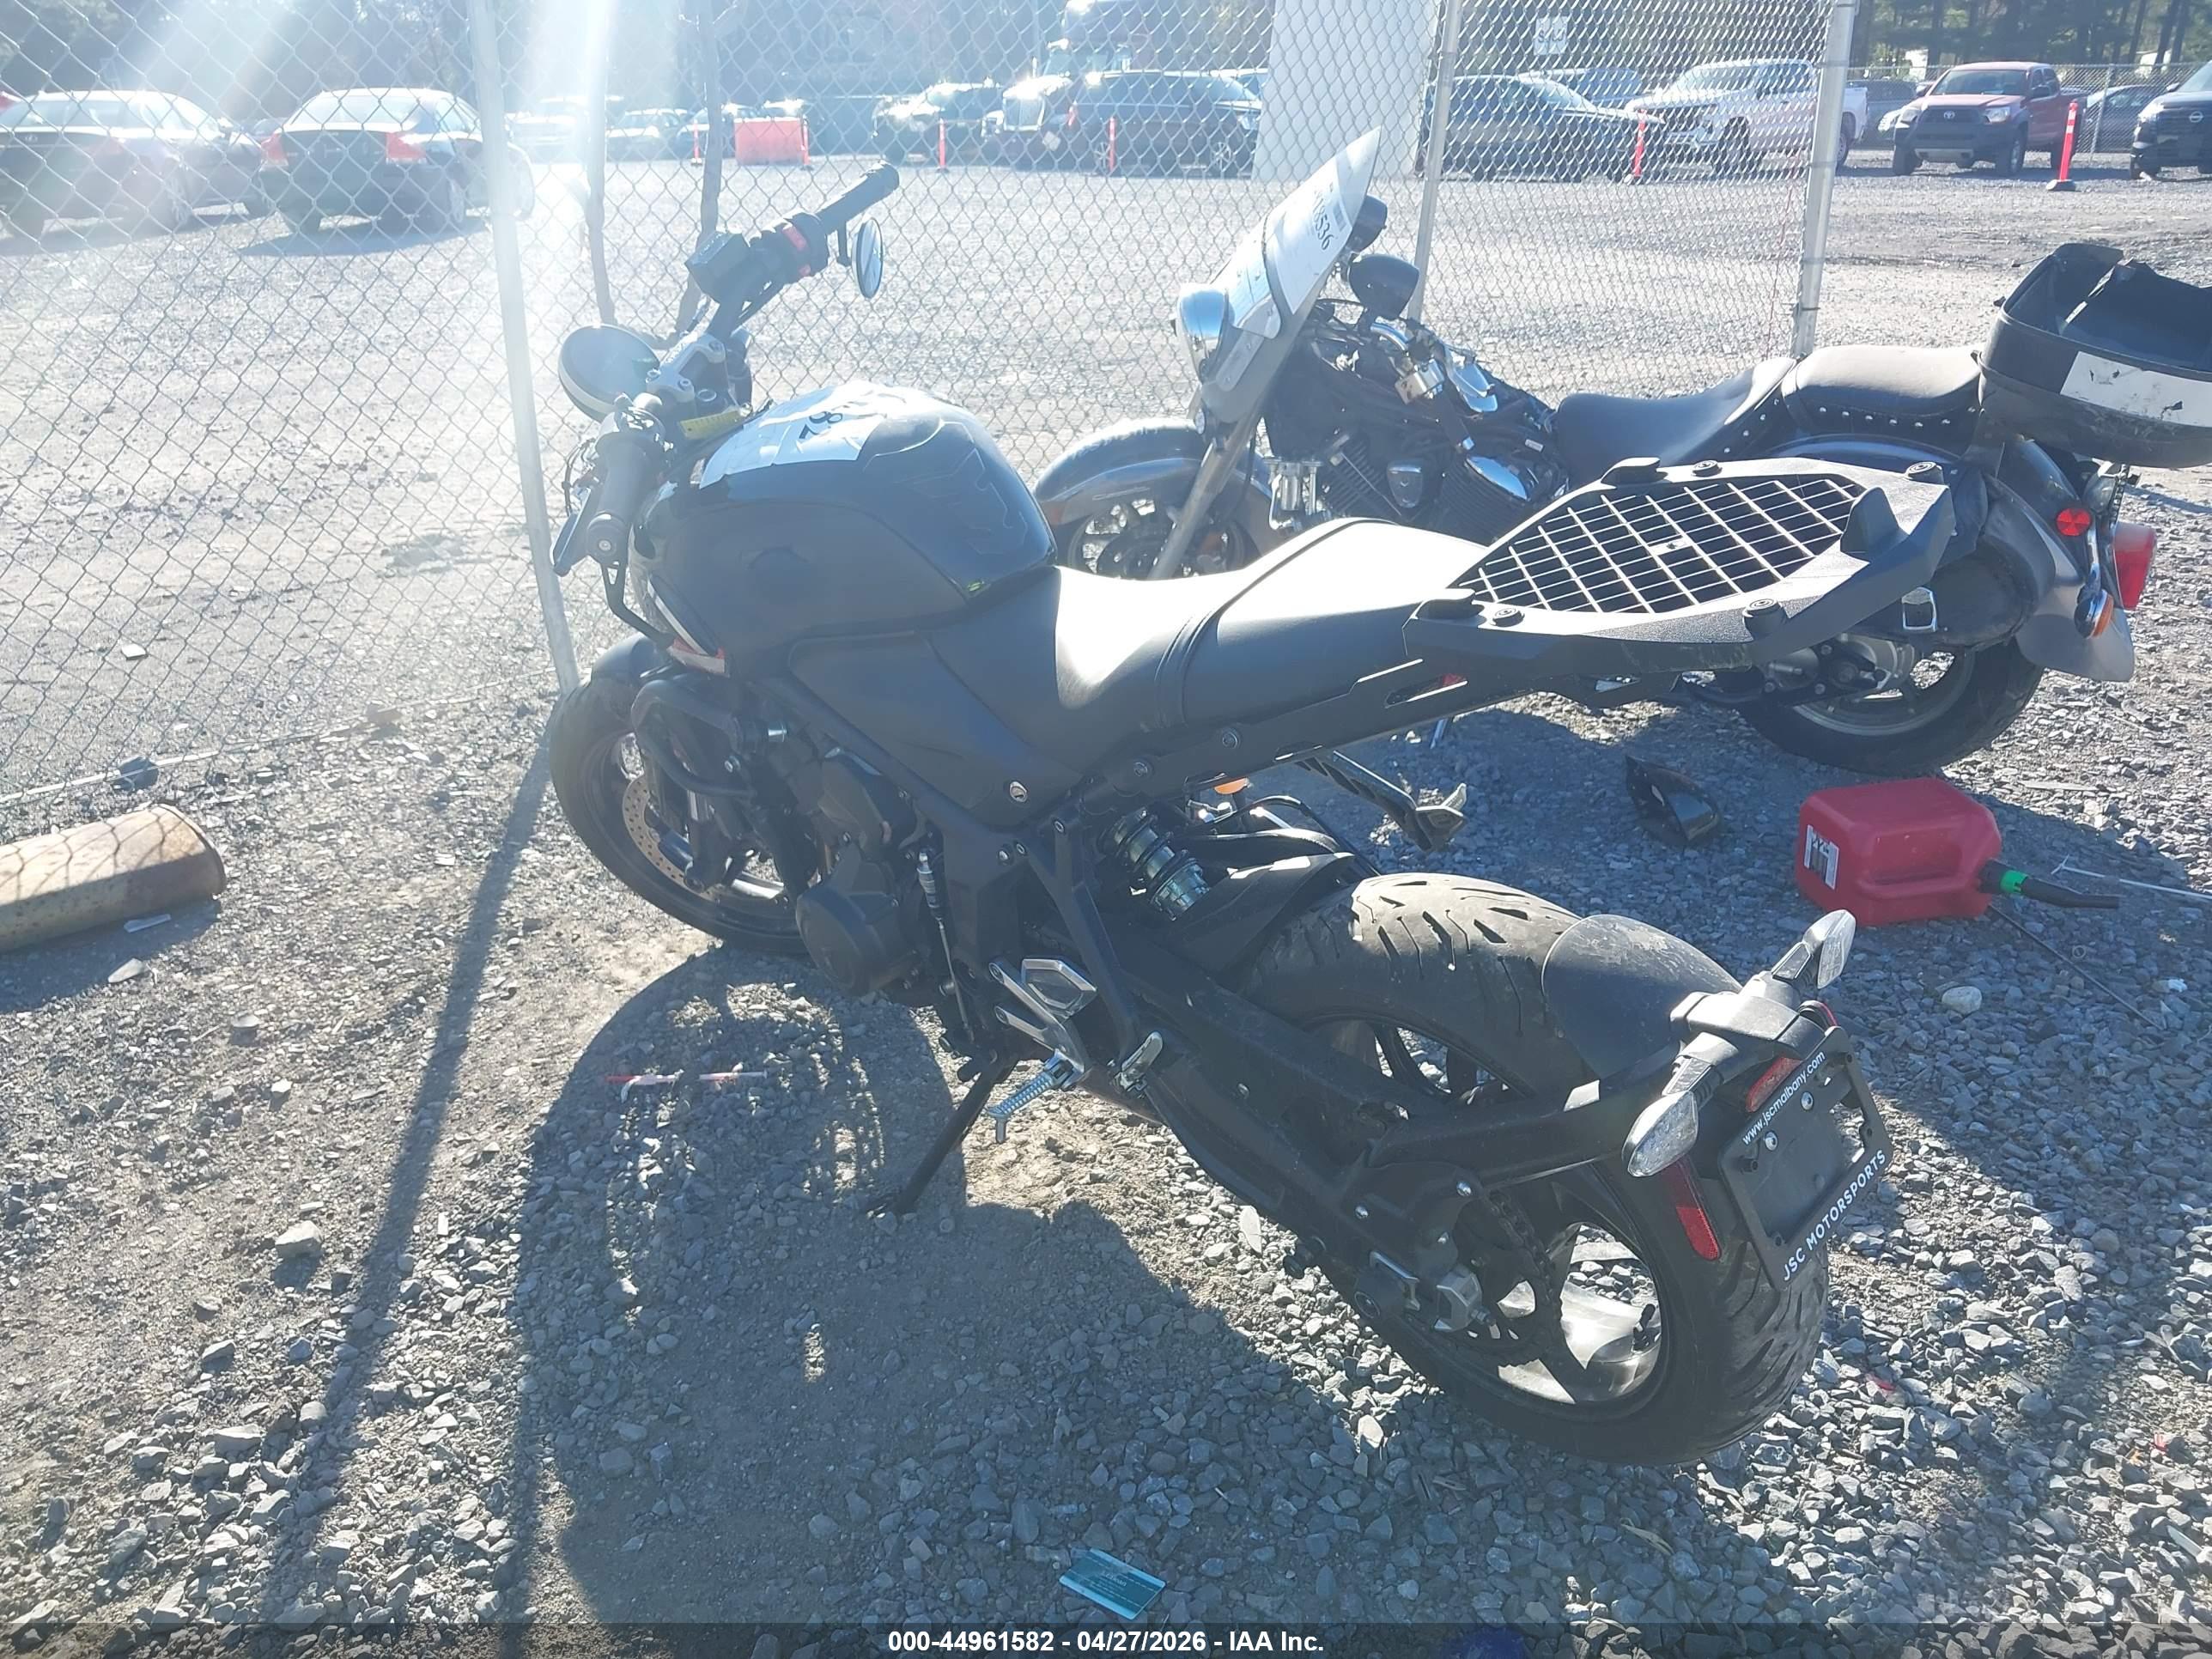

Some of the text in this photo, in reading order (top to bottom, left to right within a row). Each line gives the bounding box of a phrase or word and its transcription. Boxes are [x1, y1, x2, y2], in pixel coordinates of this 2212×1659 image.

[1742, 1050, 1826, 1146] www.jscmalbany.com
[1783, 1149, 1887, 1282] JSC MOTORSPORTS
